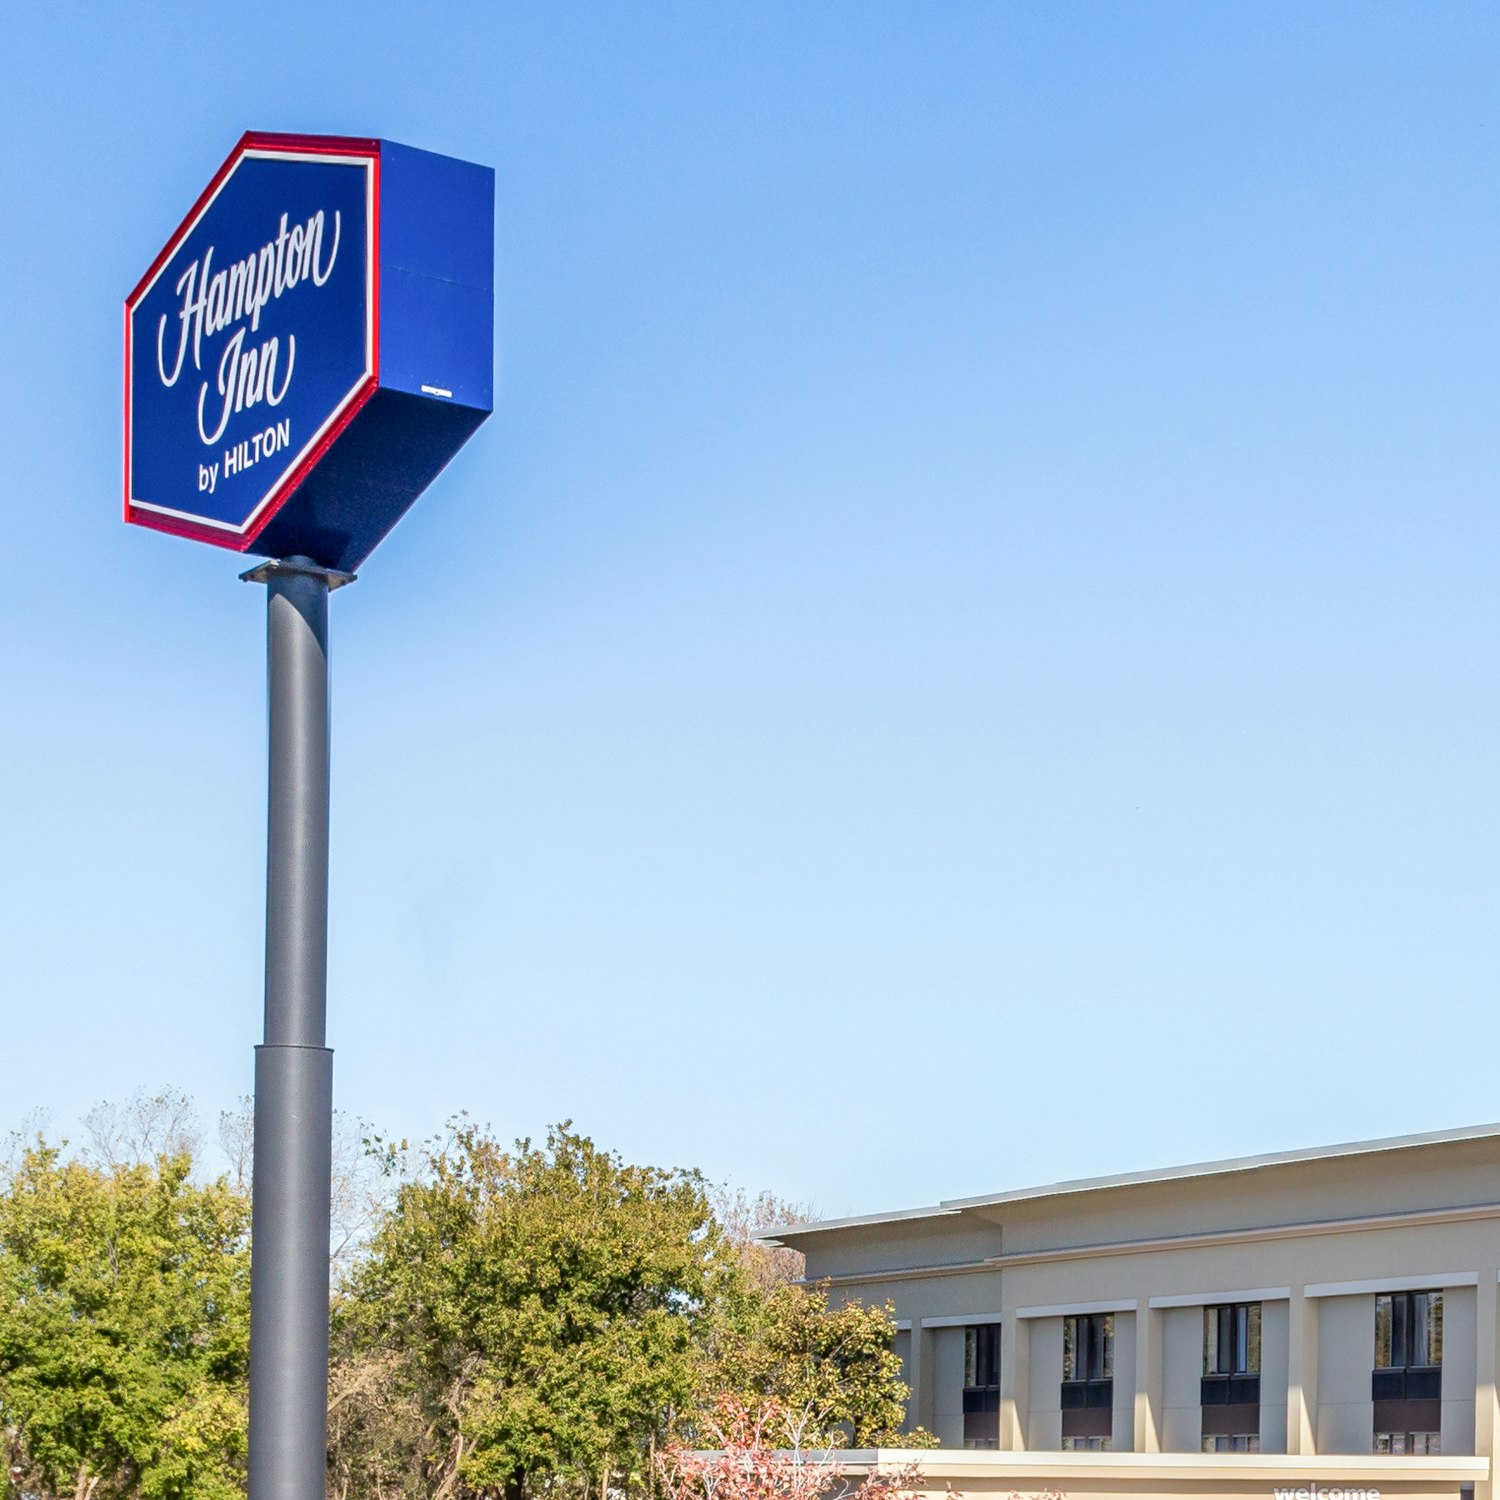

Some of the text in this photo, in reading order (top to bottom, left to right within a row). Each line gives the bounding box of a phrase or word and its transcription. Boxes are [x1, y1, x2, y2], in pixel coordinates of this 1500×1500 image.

[158, 209, 340, 387] Hampton
[198, 327, 295, 446] Inn
[199, 418, 290, 493] by HILTON
